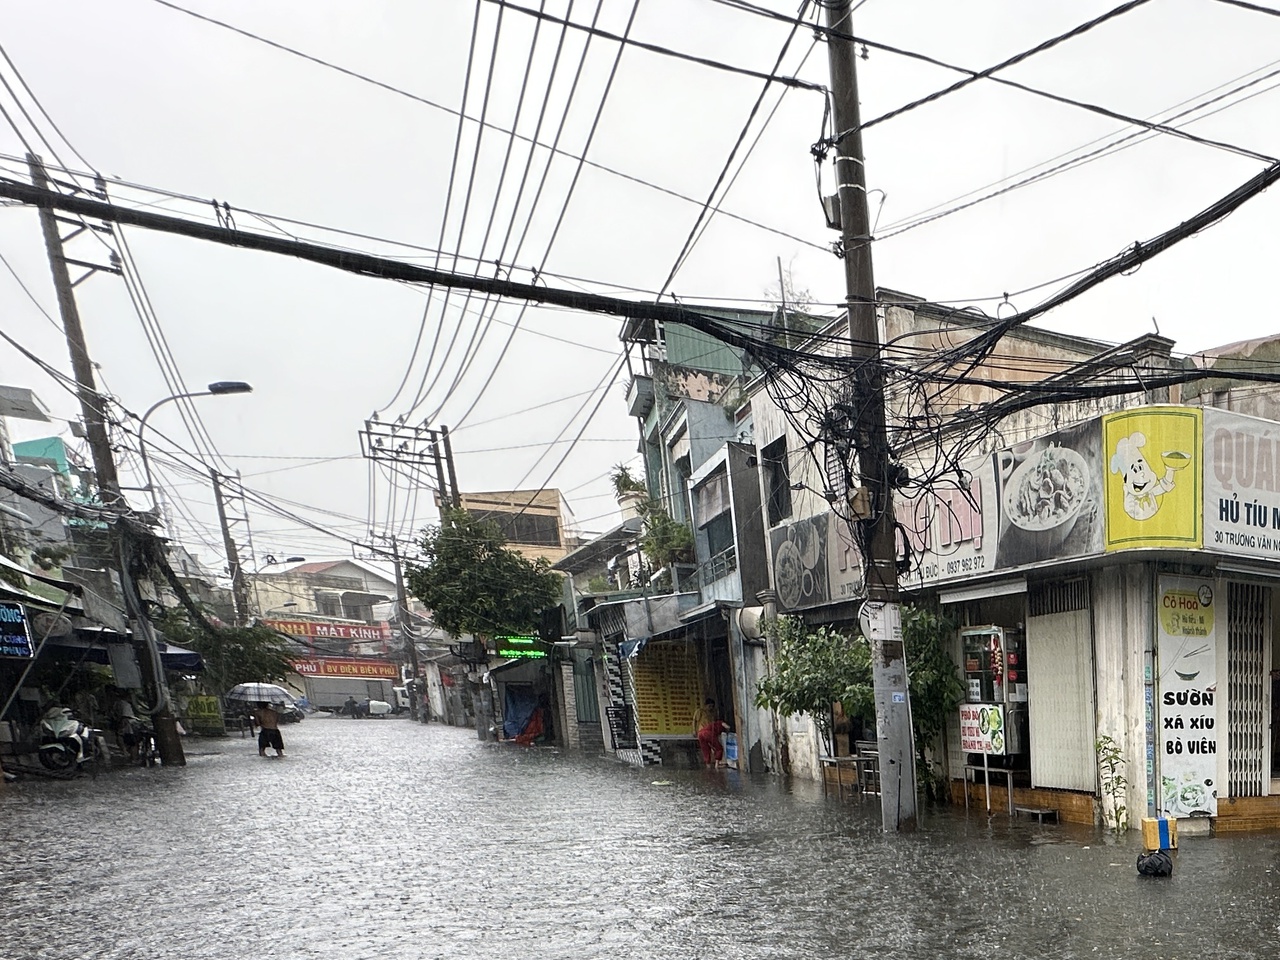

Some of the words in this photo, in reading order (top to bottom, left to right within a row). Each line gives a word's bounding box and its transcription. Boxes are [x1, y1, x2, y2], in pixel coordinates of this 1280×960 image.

[1219, 493, 1240, 523] HỦ
[1245, 500, 1268, 528] TÍU
[1214, 531, 1224, 543] 30
[1225, 532, 1255, 548] TRƯƠNG
[1257, 536, 1272, 550] VĂN
[946, 560, 961, 574] 0937
[961, 558, 973, 571] 962
[973, 556, 985, 569] 972
[1163, 595, 1176, 608] Cô
[1163, 688, 1214, 706] SƯỜN
[1163, 714, 1184, 730] XÁ
[1189, 714, 1214, 730] XÍU
[1166, 736, 1183, 755] BÒ
[1187, 736, 1217, 755] VIÊN
